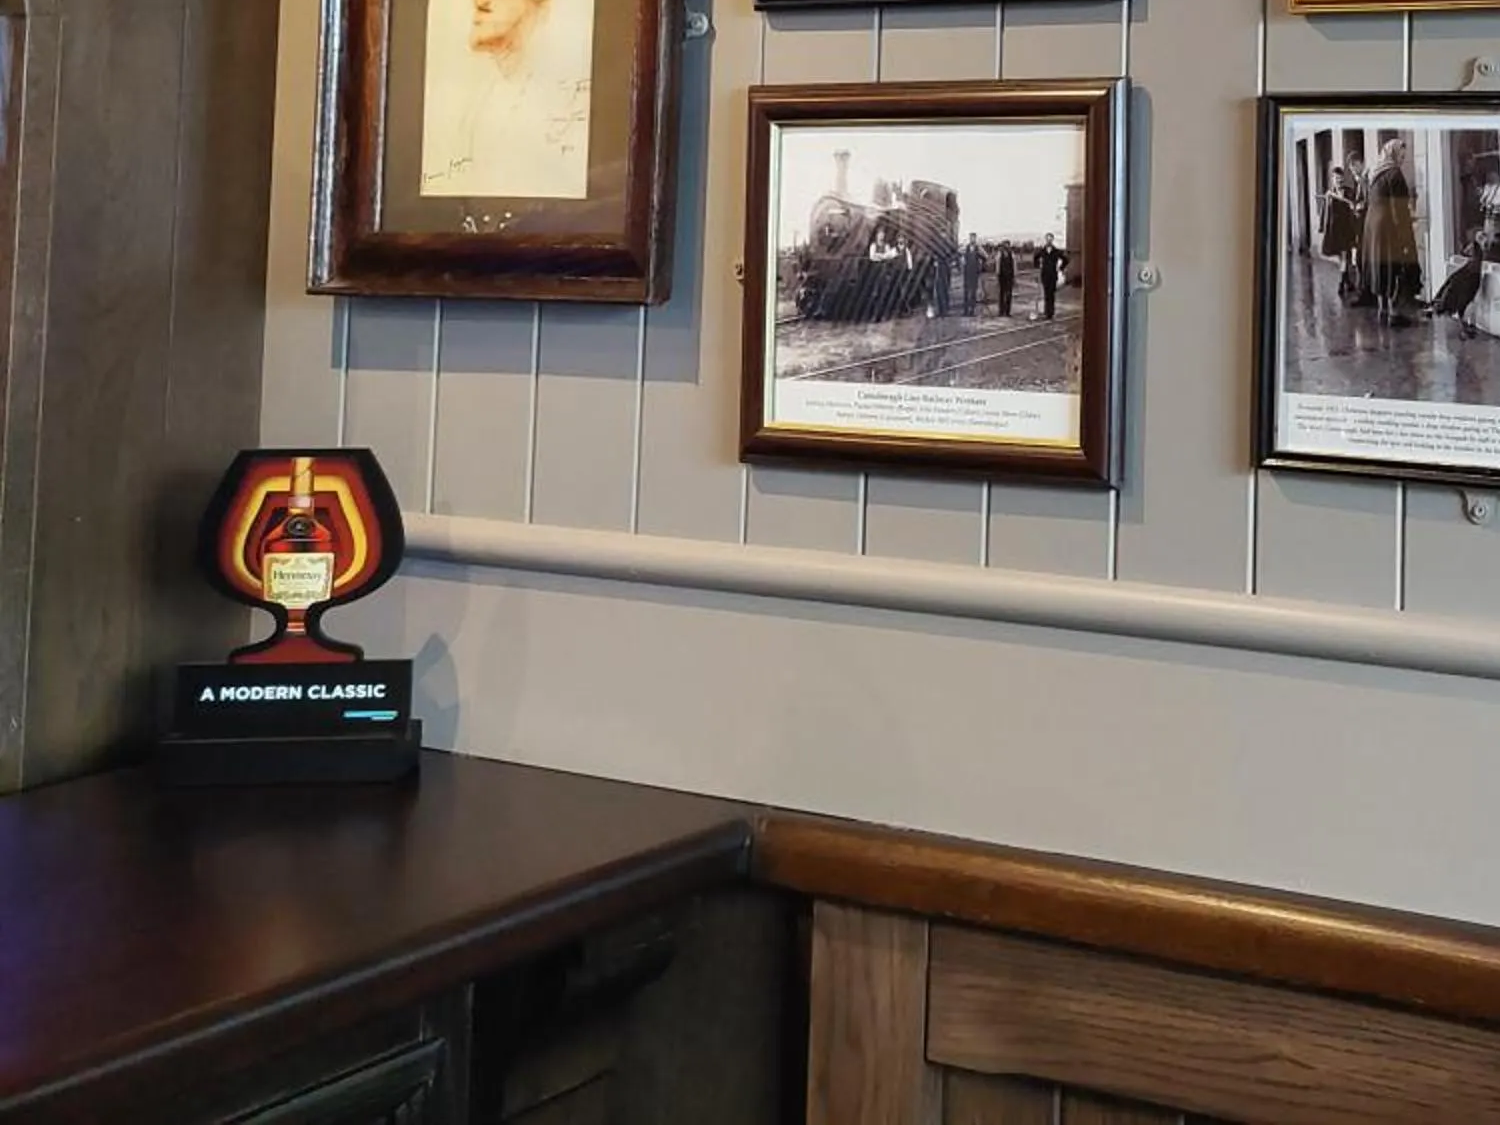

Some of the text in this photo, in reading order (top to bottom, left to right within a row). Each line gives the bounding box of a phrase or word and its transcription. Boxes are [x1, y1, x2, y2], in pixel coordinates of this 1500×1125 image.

[200, 683, 387, 702] A MODERN CLASSIC
